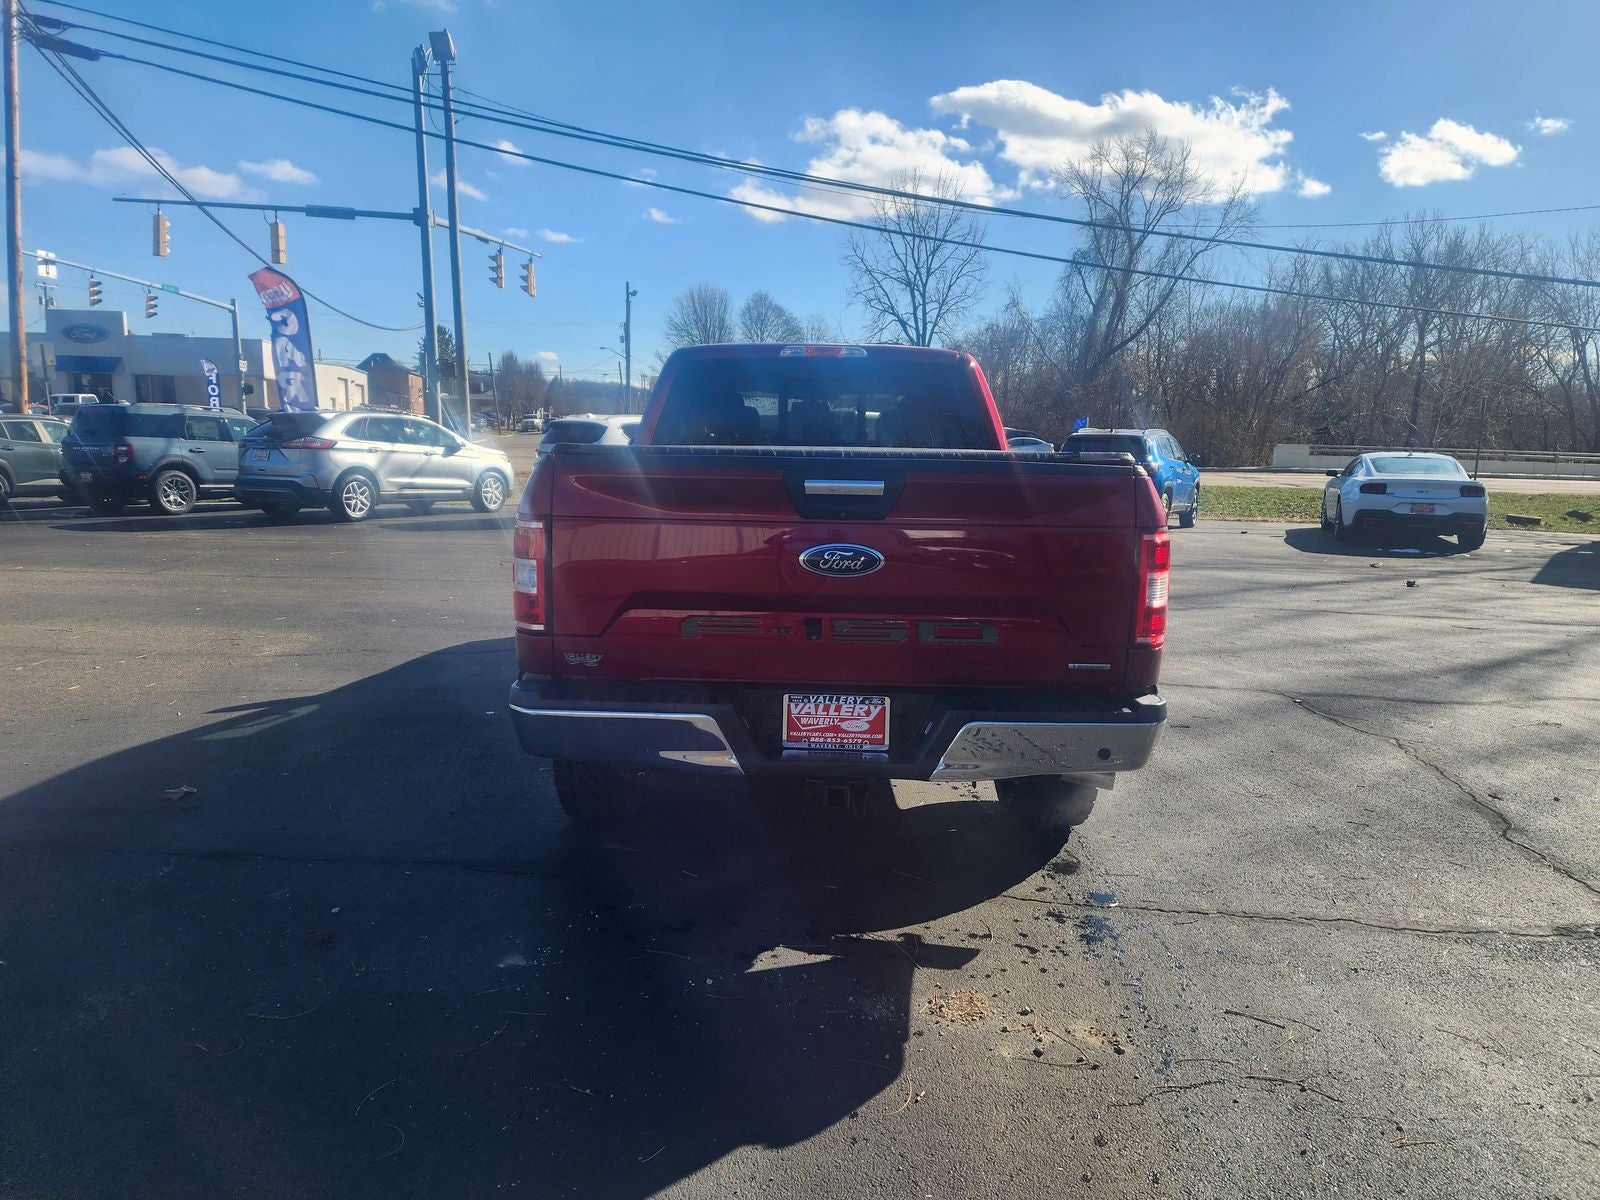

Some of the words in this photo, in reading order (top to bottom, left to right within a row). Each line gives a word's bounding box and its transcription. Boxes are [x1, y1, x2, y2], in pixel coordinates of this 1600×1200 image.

[819, 550, 868, 571] Ford
[679, 615, 1000, 644] F-150
[809, 695, 863, 704] VALLERY
[789, 703, 882, 720] VALLERY
[800, 717, 840, 726] WAVERLY
